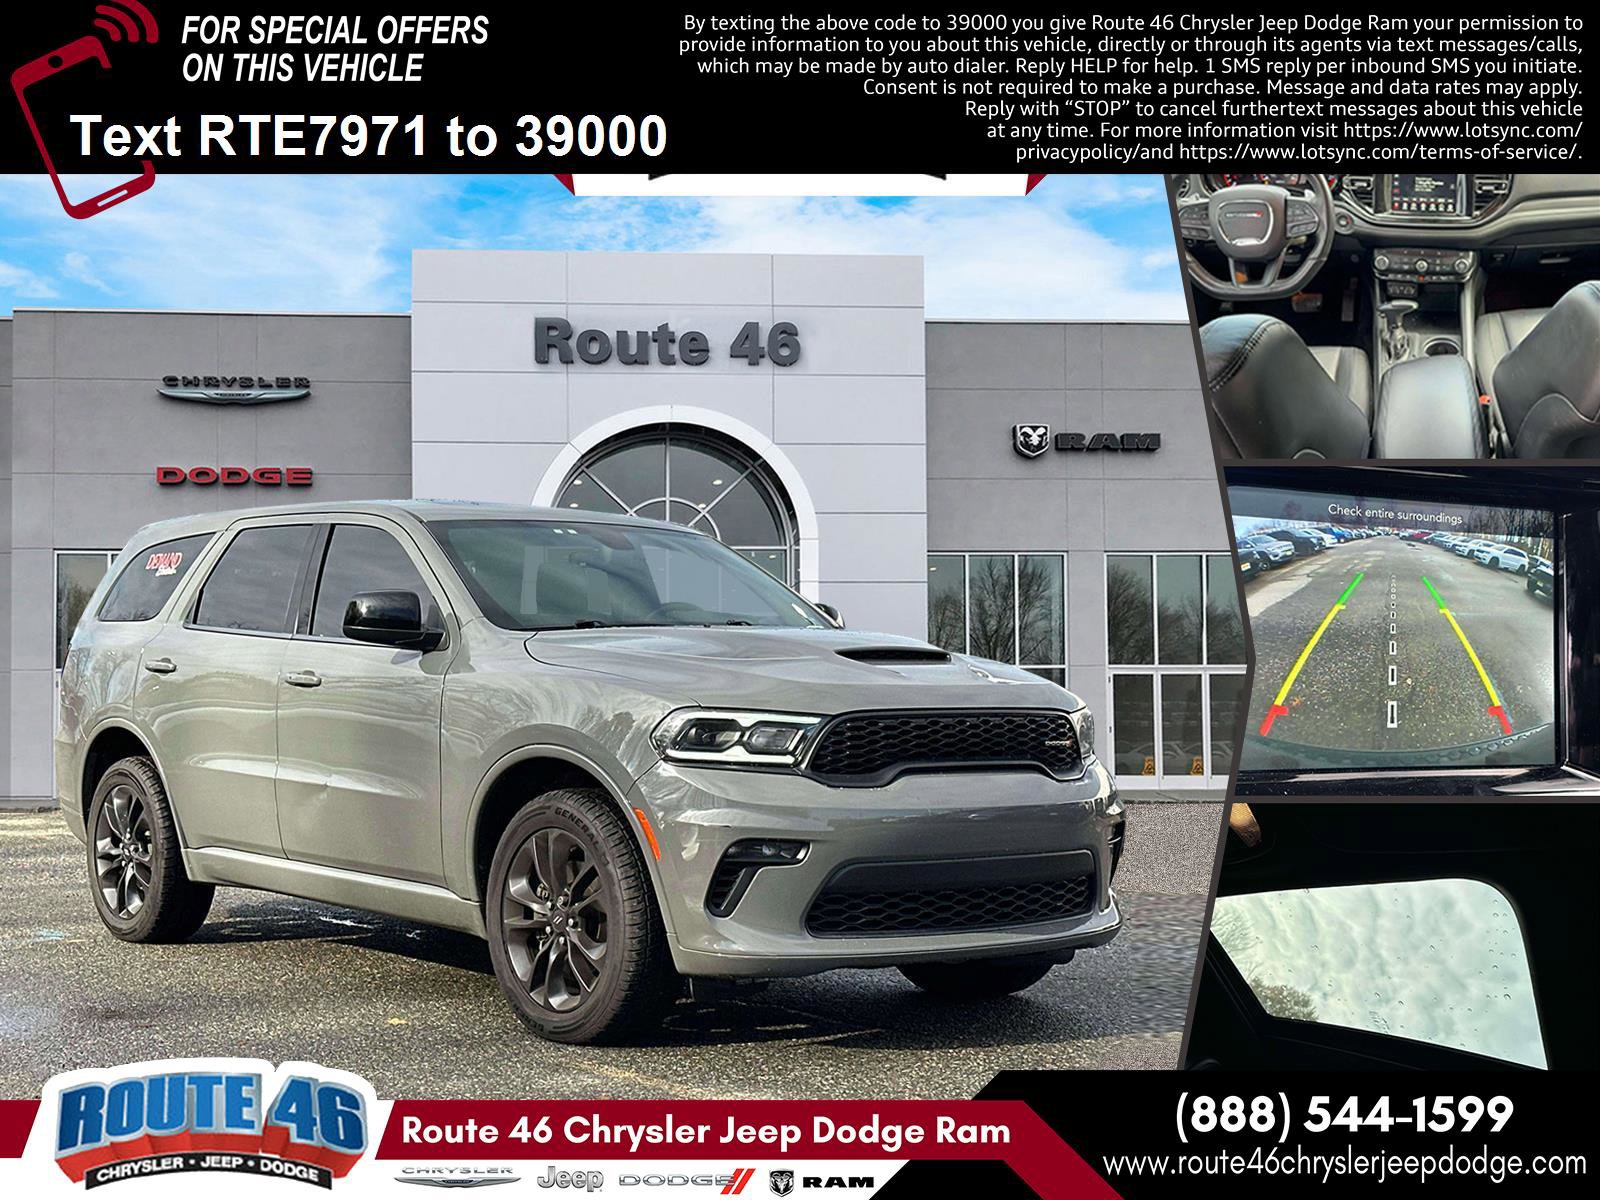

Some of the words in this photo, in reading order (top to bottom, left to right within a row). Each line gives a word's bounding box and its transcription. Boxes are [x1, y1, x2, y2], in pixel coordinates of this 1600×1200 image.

[534, 317, 710, 364] Route
[730, 320, 801, 367] 46
[162, 375, 311, 388] CHRYSLER
[1054, 432, 1162, 452] RAM
[156, 467, 313, 486] DODGE
[1328, 503, 1362, 516] Check
[1365, 508, 1394, 519] entire
[1397, 510, 1463, 526] surroundings
